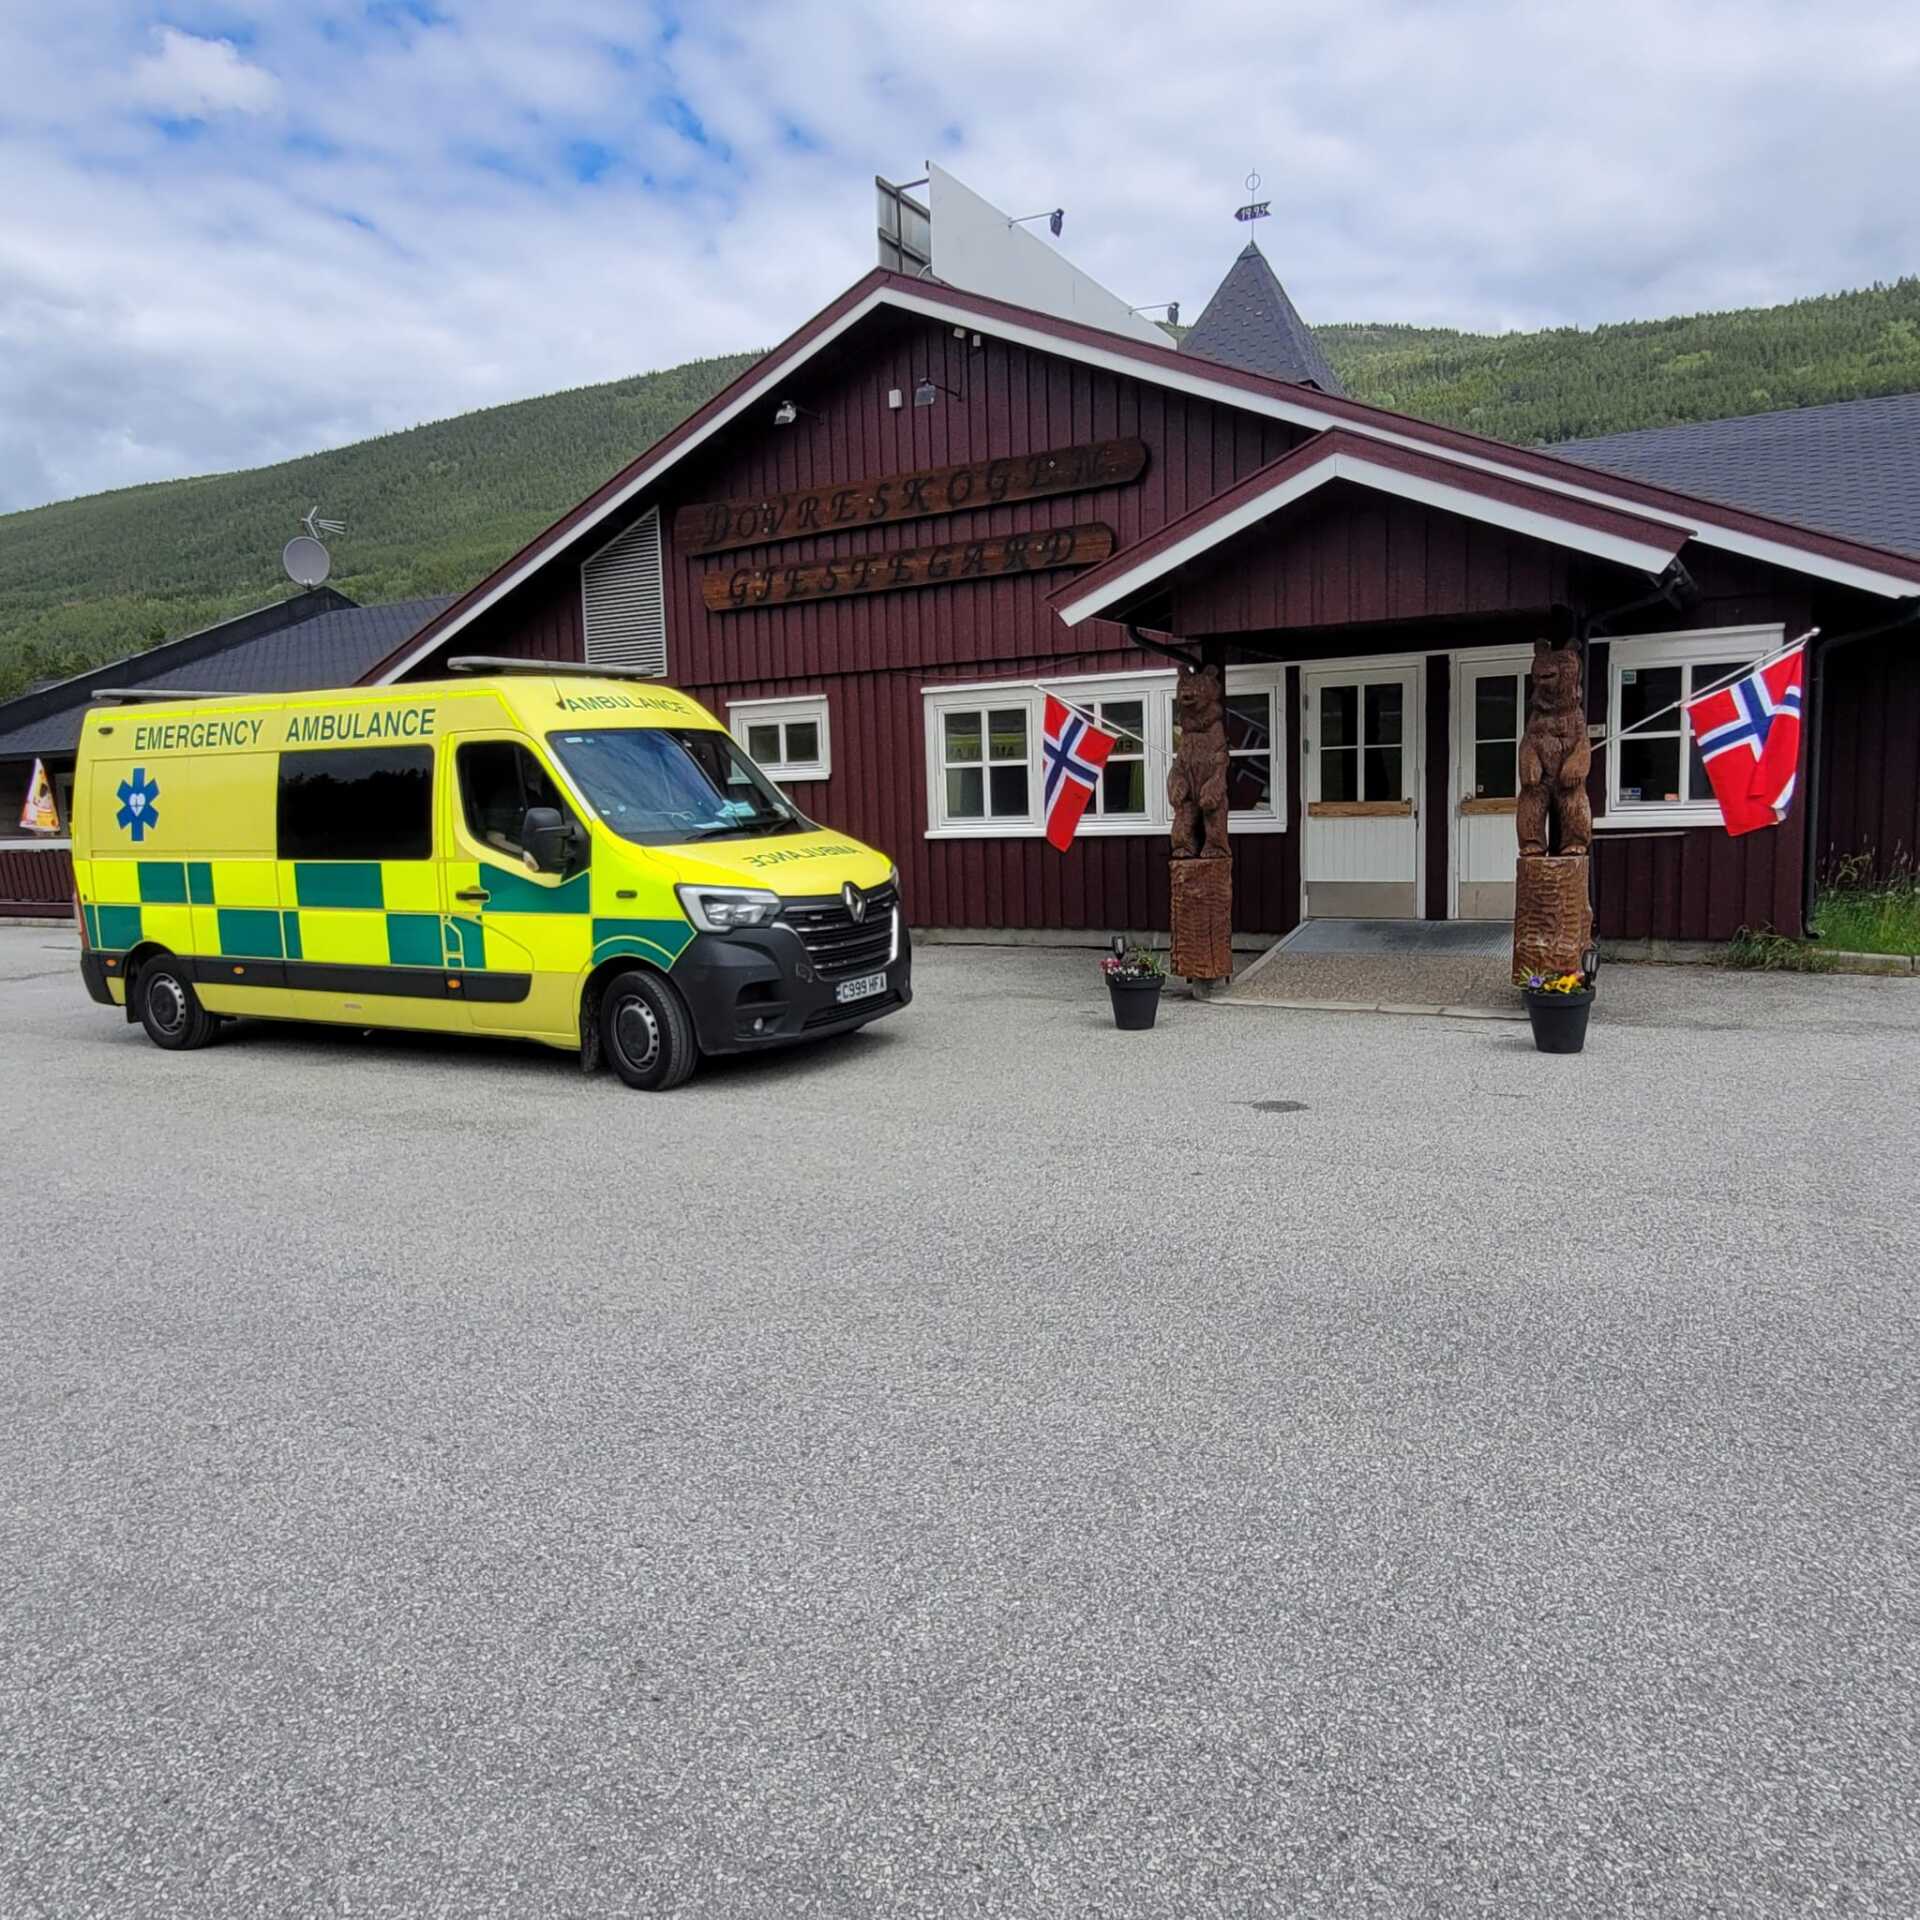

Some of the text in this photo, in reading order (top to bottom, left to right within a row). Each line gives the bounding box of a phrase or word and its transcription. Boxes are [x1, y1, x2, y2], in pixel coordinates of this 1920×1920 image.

[702, 448, 1105, 547] DOVRESKOGEN
[565, 696, 692, 715] AMBULANCE
[135, 708, 436, 751] EMERGENCY AMBULANCE
[842, 975, 885, 999] C999 HFA
